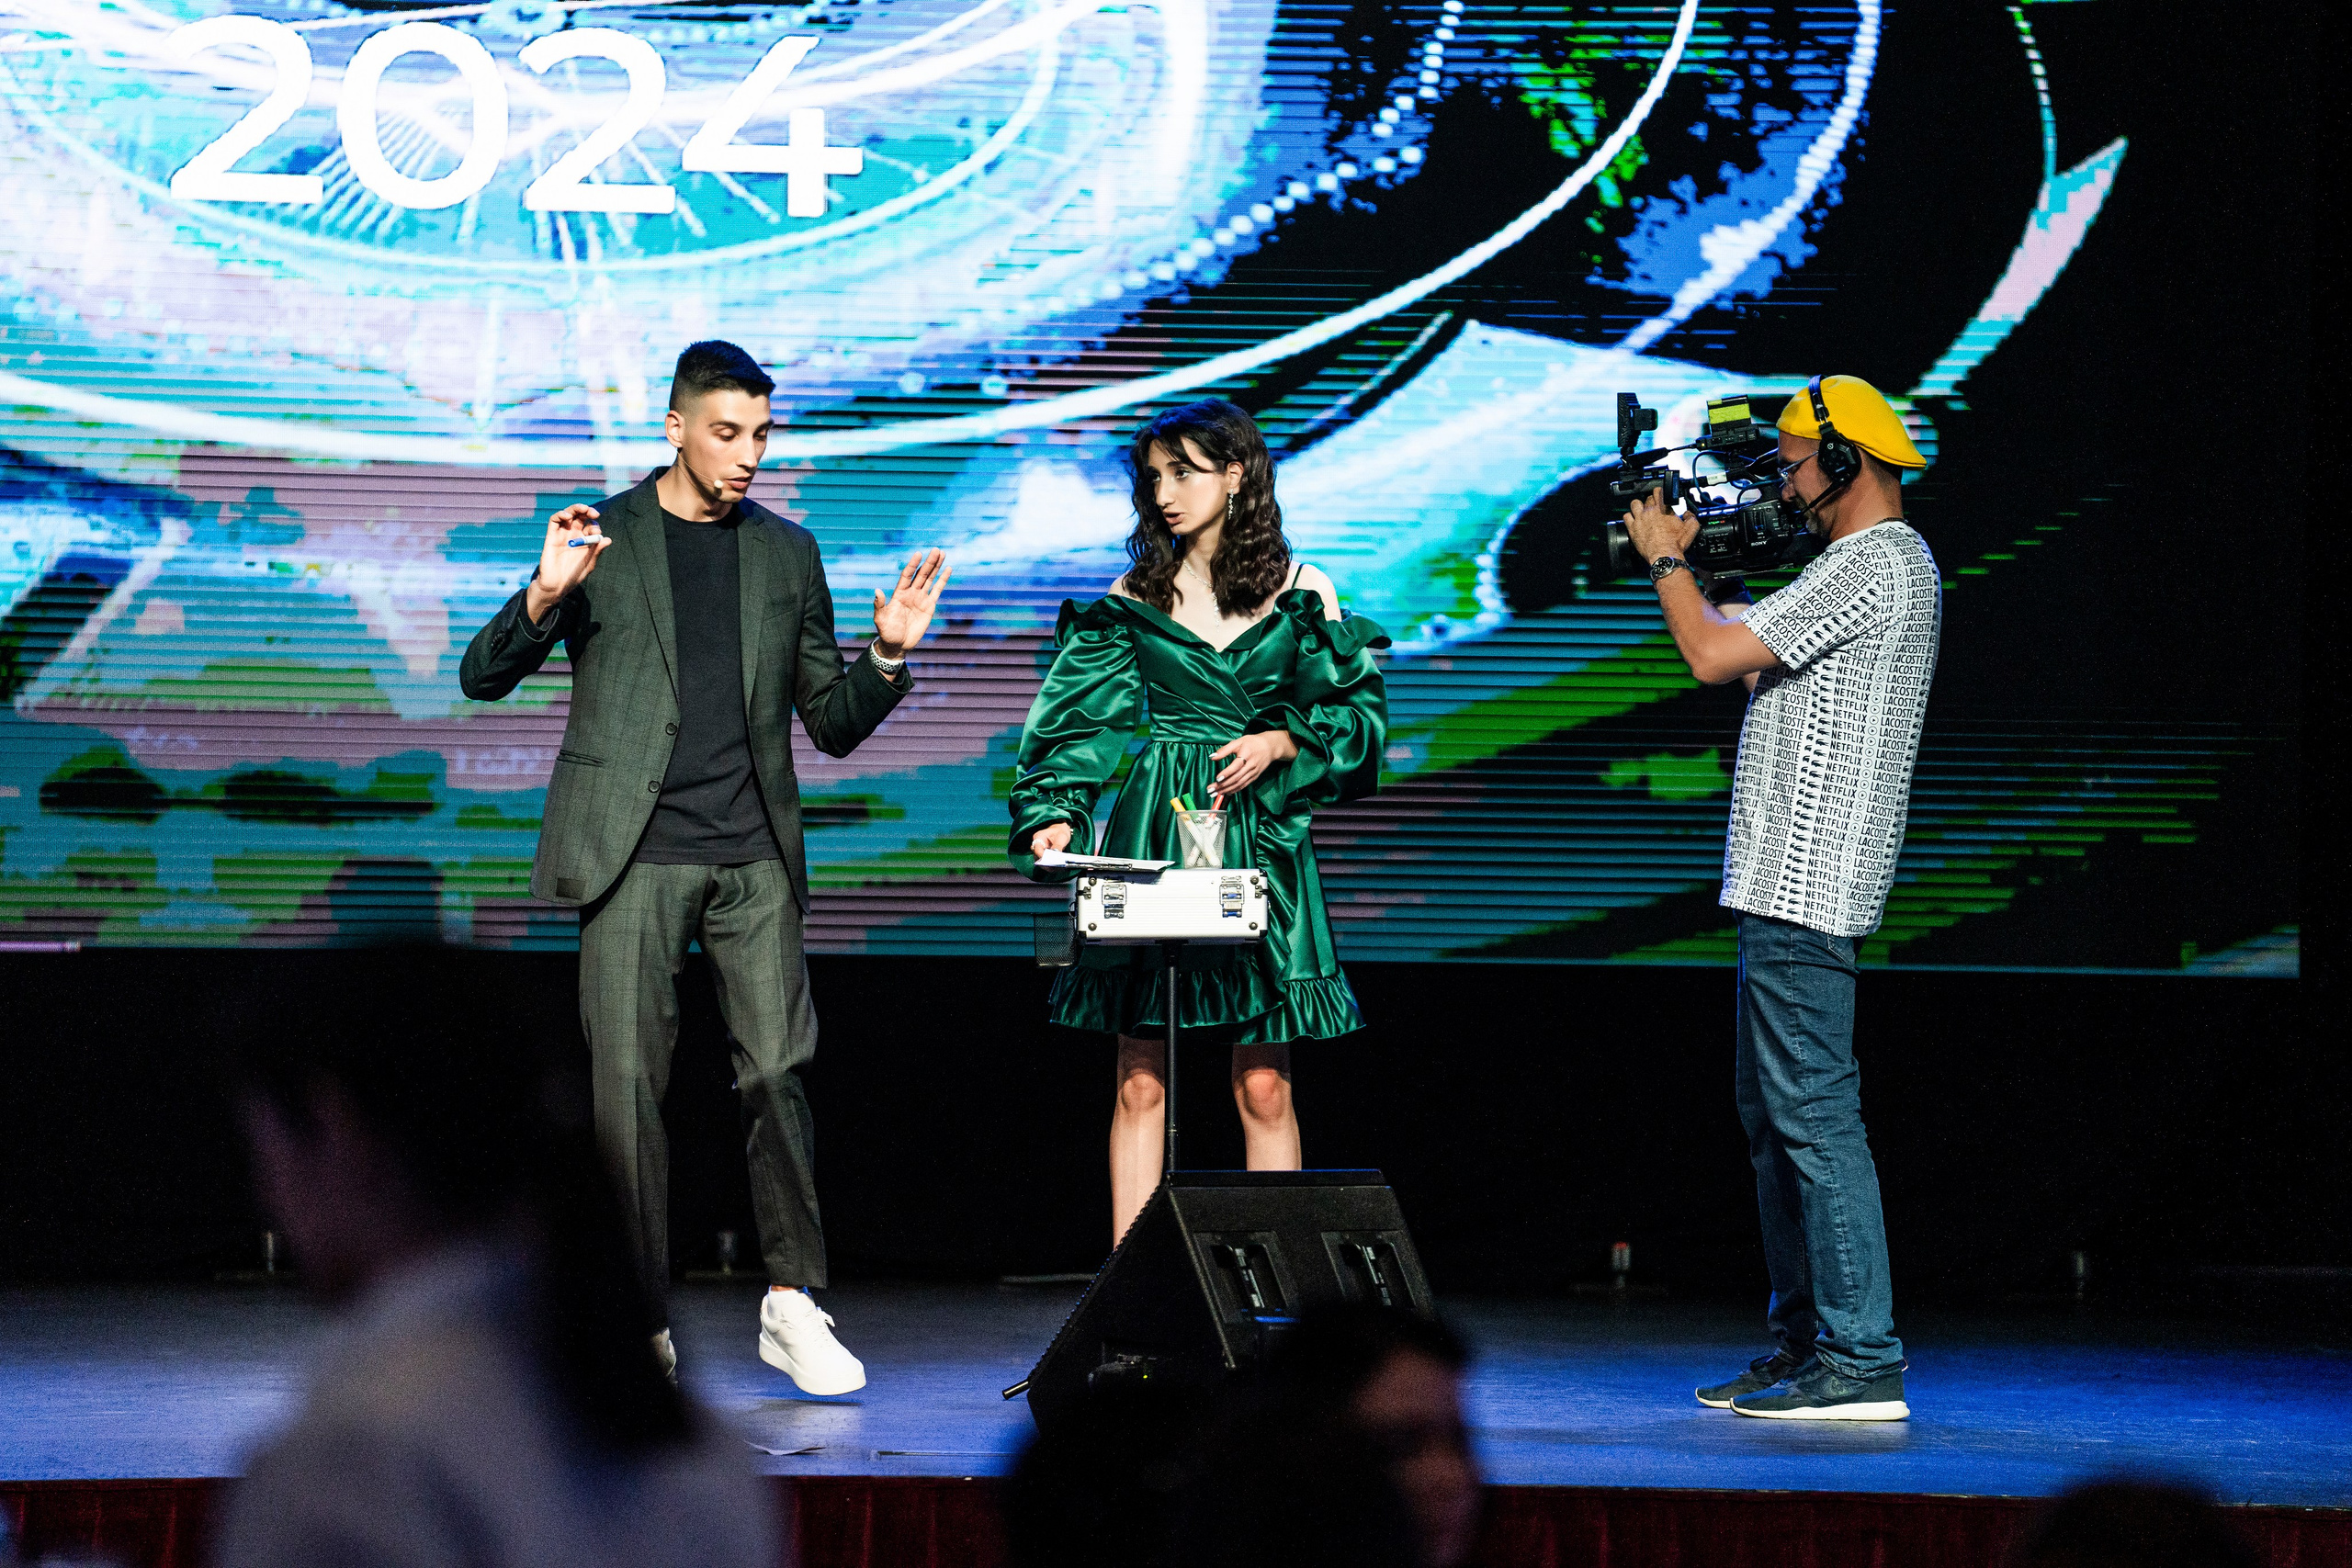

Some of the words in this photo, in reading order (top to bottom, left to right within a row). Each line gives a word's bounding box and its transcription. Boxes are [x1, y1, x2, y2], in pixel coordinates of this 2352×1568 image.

[171, 15, 863, 218] 2024
[1871, 551, 1889, 559] FLIX
[1896, 547, 1920, 556] LACOSTE
[1846, 555, 1879, 581] LACOSTE
[1874, 560, 1893, 570] FLIX
[1902, 555, 1928, 566] LACOSTE
[1838, 562, 1871, 589] LACOSTE
[1905, 566, 1930, 577] LACOSTE
[1829, 570, 1861, 597] LACOSTE
[1907, 577, 1932, 588] LACOSTE
[1820, 578, 1852, 605] LACOSTE
[1907, 588, 1932, 600] LACOSTE
[1907, 600, 1932, 611] LACOSTE
[1905, 612, 1931, 621] LACOSTE
[1769, 615, 1799, 645] LACOSTE
[1902, 623, 1930, 632] LACOSTE
[1760, 623, 1792, 653] LACOSTE
[1898, 634, 1928, 643] LACOSTE
[1895, 645, 1926, 654] LACOSTE
[1839, 655, 1876, 671] NETFLIX
[1889, 664, 1922, 675] LACOSTE
[1892, 654, 1924, 664] LACOSTE
[1838, 665, 1873, 682] NETFLIX
[1887, 674, 1920, 686] LACOSTE
[1782, 680, 1810, 695] ACOSTE
[1836, 676, 1871, 692] NETFLIX
[1885, 684, 1917, 696] LACOSTE
[1755, 698, 1772, 709] ETFLIX
[1834, 687, 1870, 702] NETFLIX
[1883, 695, 1916, 707] LACOSTE
[1834, 698, 1868, 713] NETFLIX
[1883, 706, 1914, 718] LACOSTE
[1834, 708, 1867, 723] NETFLIX
[1881, 717, 1911, 729] LACOSTE
[1777, 726, 1804, 739] LACOSTE
[1833, 719, 1865, 736] NETFLIX
[1880, 728, 1909, 739] LACOSTE
[1775, 737, 1801, 750] LACOSTE
[1832, 730, 1864, 745] NETFLIX
[1879, 739, 1907, 750] LACOSTE
[1774, 748, 1799, 761] LACOSTE
[1830, 740, 1863, 755] NETFLIX
[1876, 750, 1905, 761] LACOSTE
[1773, 758, 1798, 773] LACOSTE
[1828, 751, 1861, 766] NETFLIX
[1874, 760, 1902, 773] LACOSTE
[1743, 764, 1763, 775] NETFLIX
[1771, 769, 1796, 784] LACOSTE
[1826, 762, 1860, 777] NETFLIX
[1873, 771, 1900, 784] LACOSTE
[1742, 775, 1761, 786] NETFLIX
[1770, 781, 1795, 795] LACOSTE
[1824, 773, 1859, 787] NETFLIX
[1871, 782, 1897, 795] LACOSTE
[1768, 792, 1793, 807] LACOSTE
[1822, 784, 1857, 798] NETFLIX
[1869, 793, 1895, 807] LACOSTE
[1767, 803, 1792, 817] LACOSTE
[1820, 794, 1854, 809] NETFLIX
[1867, 804, 1894, 818] LACOSTE
[1766, 813, 1792, 828] LACOSTE
[1817, 805, 1851, 819] NETFLIX
[1864, 815, 1892, 829] LACOSTE
[1763, 824, 1790, 839] LACOSTE
[1813, 827, 1847, 841] NETFLIX
[1815, 816, 1849, 830] NETFLIX
[1861, 826, 1888, 839] LACOSTE
[1760, 834, 1787, 849] LACOSTE
[1811, 837, 1843, 852] NETFLIX
[1758, 845, 1785, 860] LACOSTE
[1809, 848, 1841, 863] NETFLIX
[1854, 858, 1883, 871] LACOSTE
[1757, 856, 1782, 870] LACOSTE
[1808, 858, 1840, 874] NETFLIX
[1853, 869, 1880, 882] LACOSTE
[1753, 866, 1781, 881] LACOSTE
[1750, 876, 1778, 891] LACOSTE
[1806, 880, 1839, 894] NETFLIX
[1847, 890, 1873, 902] LACOSTE
[1849, 880, 1876, 892] LACOSTE
[1747, 886, 1775, 900] LACOSTE
[1805, 890, 1838, 905] NETFLIX
[1745, 897, 1771, 910] LACOSTE
[1804, 900, 1838, 916] NETFLIX
[1804, 911, 1836, 927] NETFLIX
